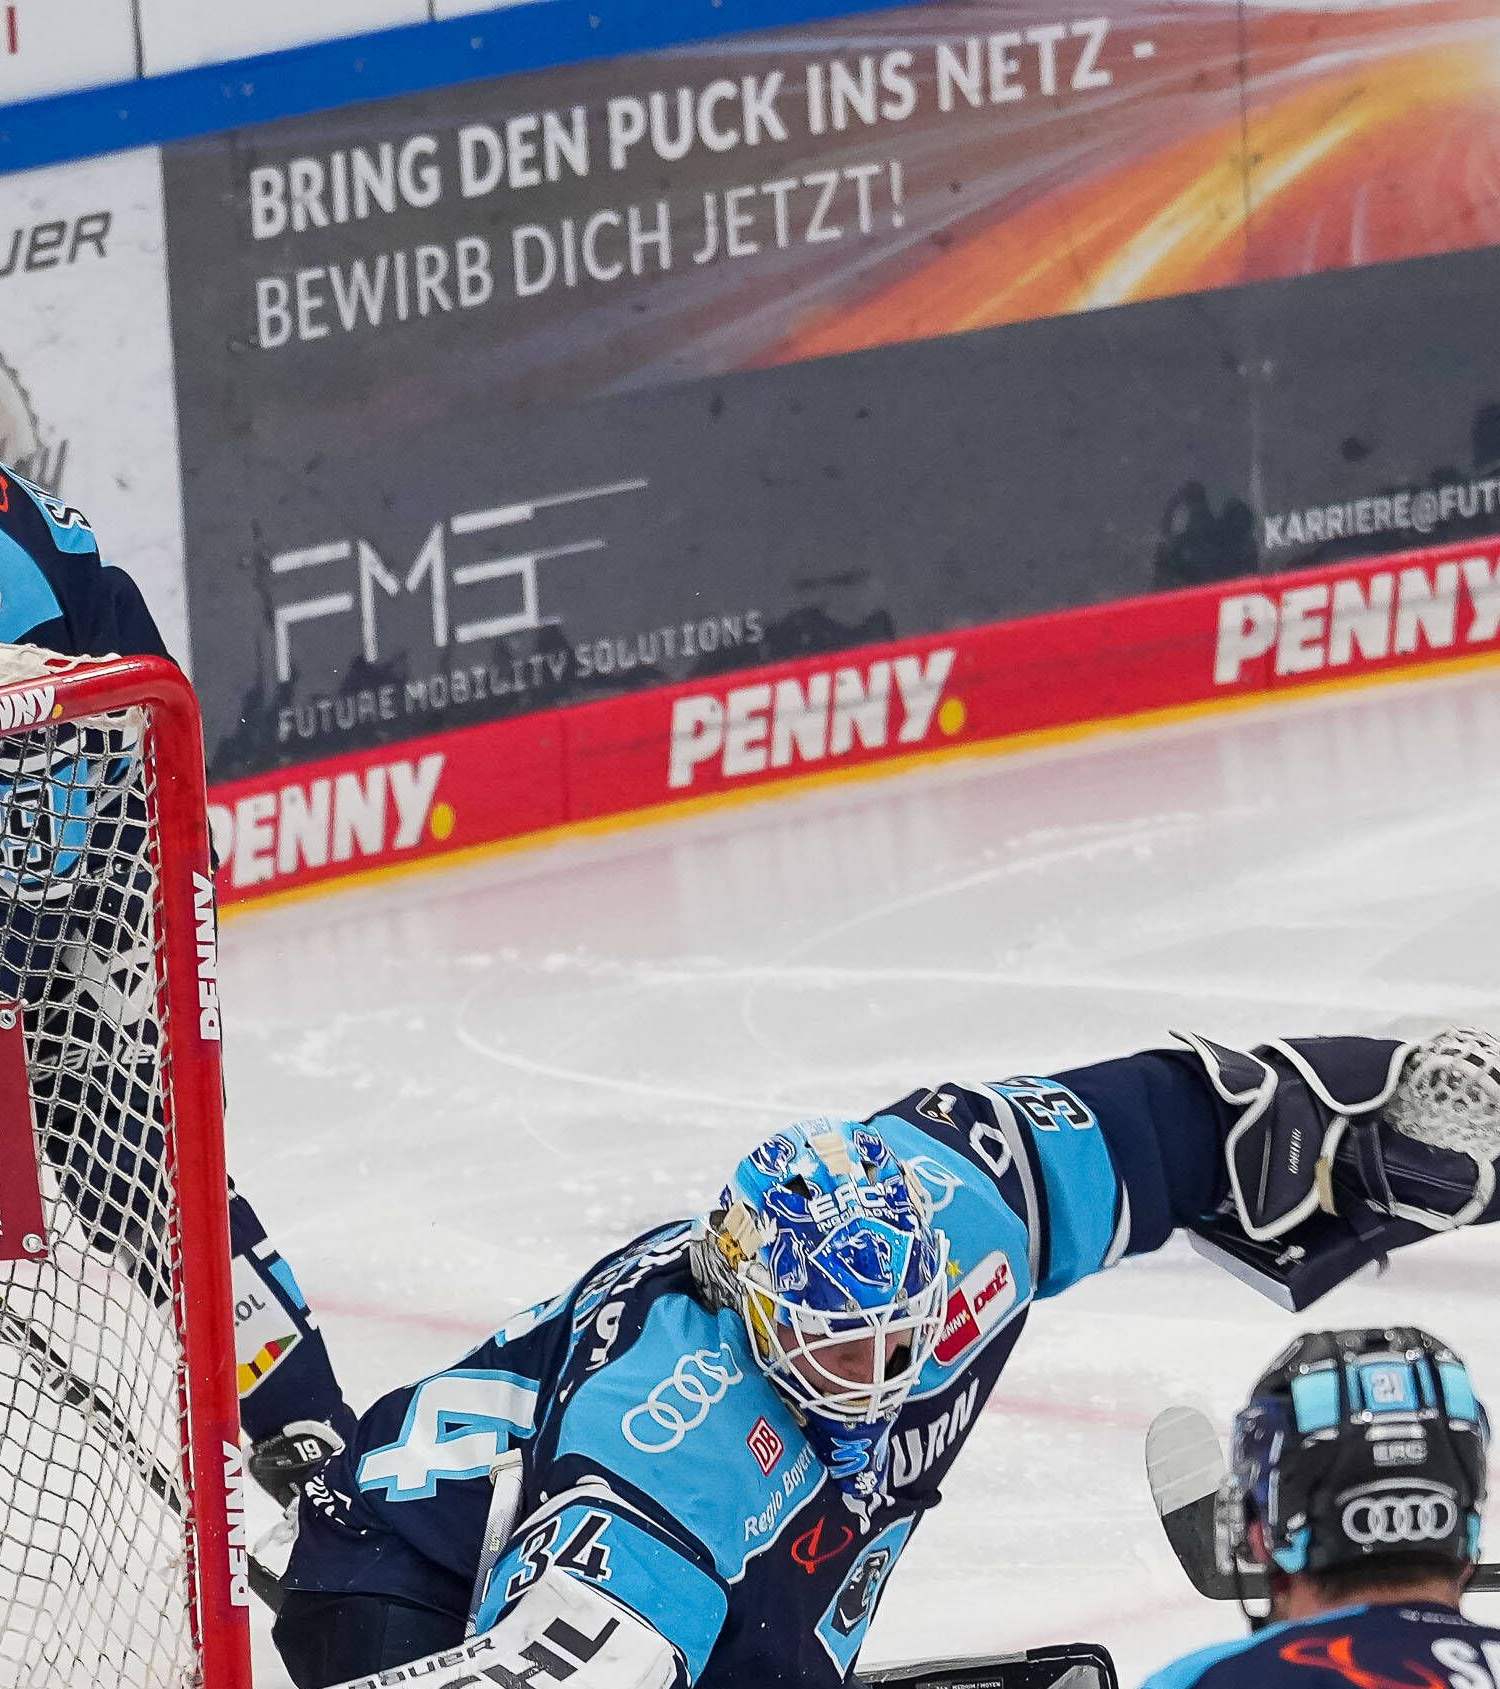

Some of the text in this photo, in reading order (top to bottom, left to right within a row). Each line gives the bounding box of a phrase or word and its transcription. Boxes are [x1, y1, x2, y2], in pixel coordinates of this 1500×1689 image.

[249, 137, 443, 241] BRING
[460, 101, 588, 196] DEN
[609, 69, 788, 170] PUCK
[807, 49, 917, 135] INS
[936, 18, 1112, 112] NETZ
[257, 159, 908, 350] BEWIRB DICH JETZT!
[276, 611, 766, 744] FUTURE MOBILITY SOLUTIONS
[292, 1438, 324, 1463] 19
[749, 1418, 782, 1476] DB
[890, 1377, 981, 1488] URN
[506, 1511, 613, 1603] 34
[743, 1491, 784, 1542] Regio
